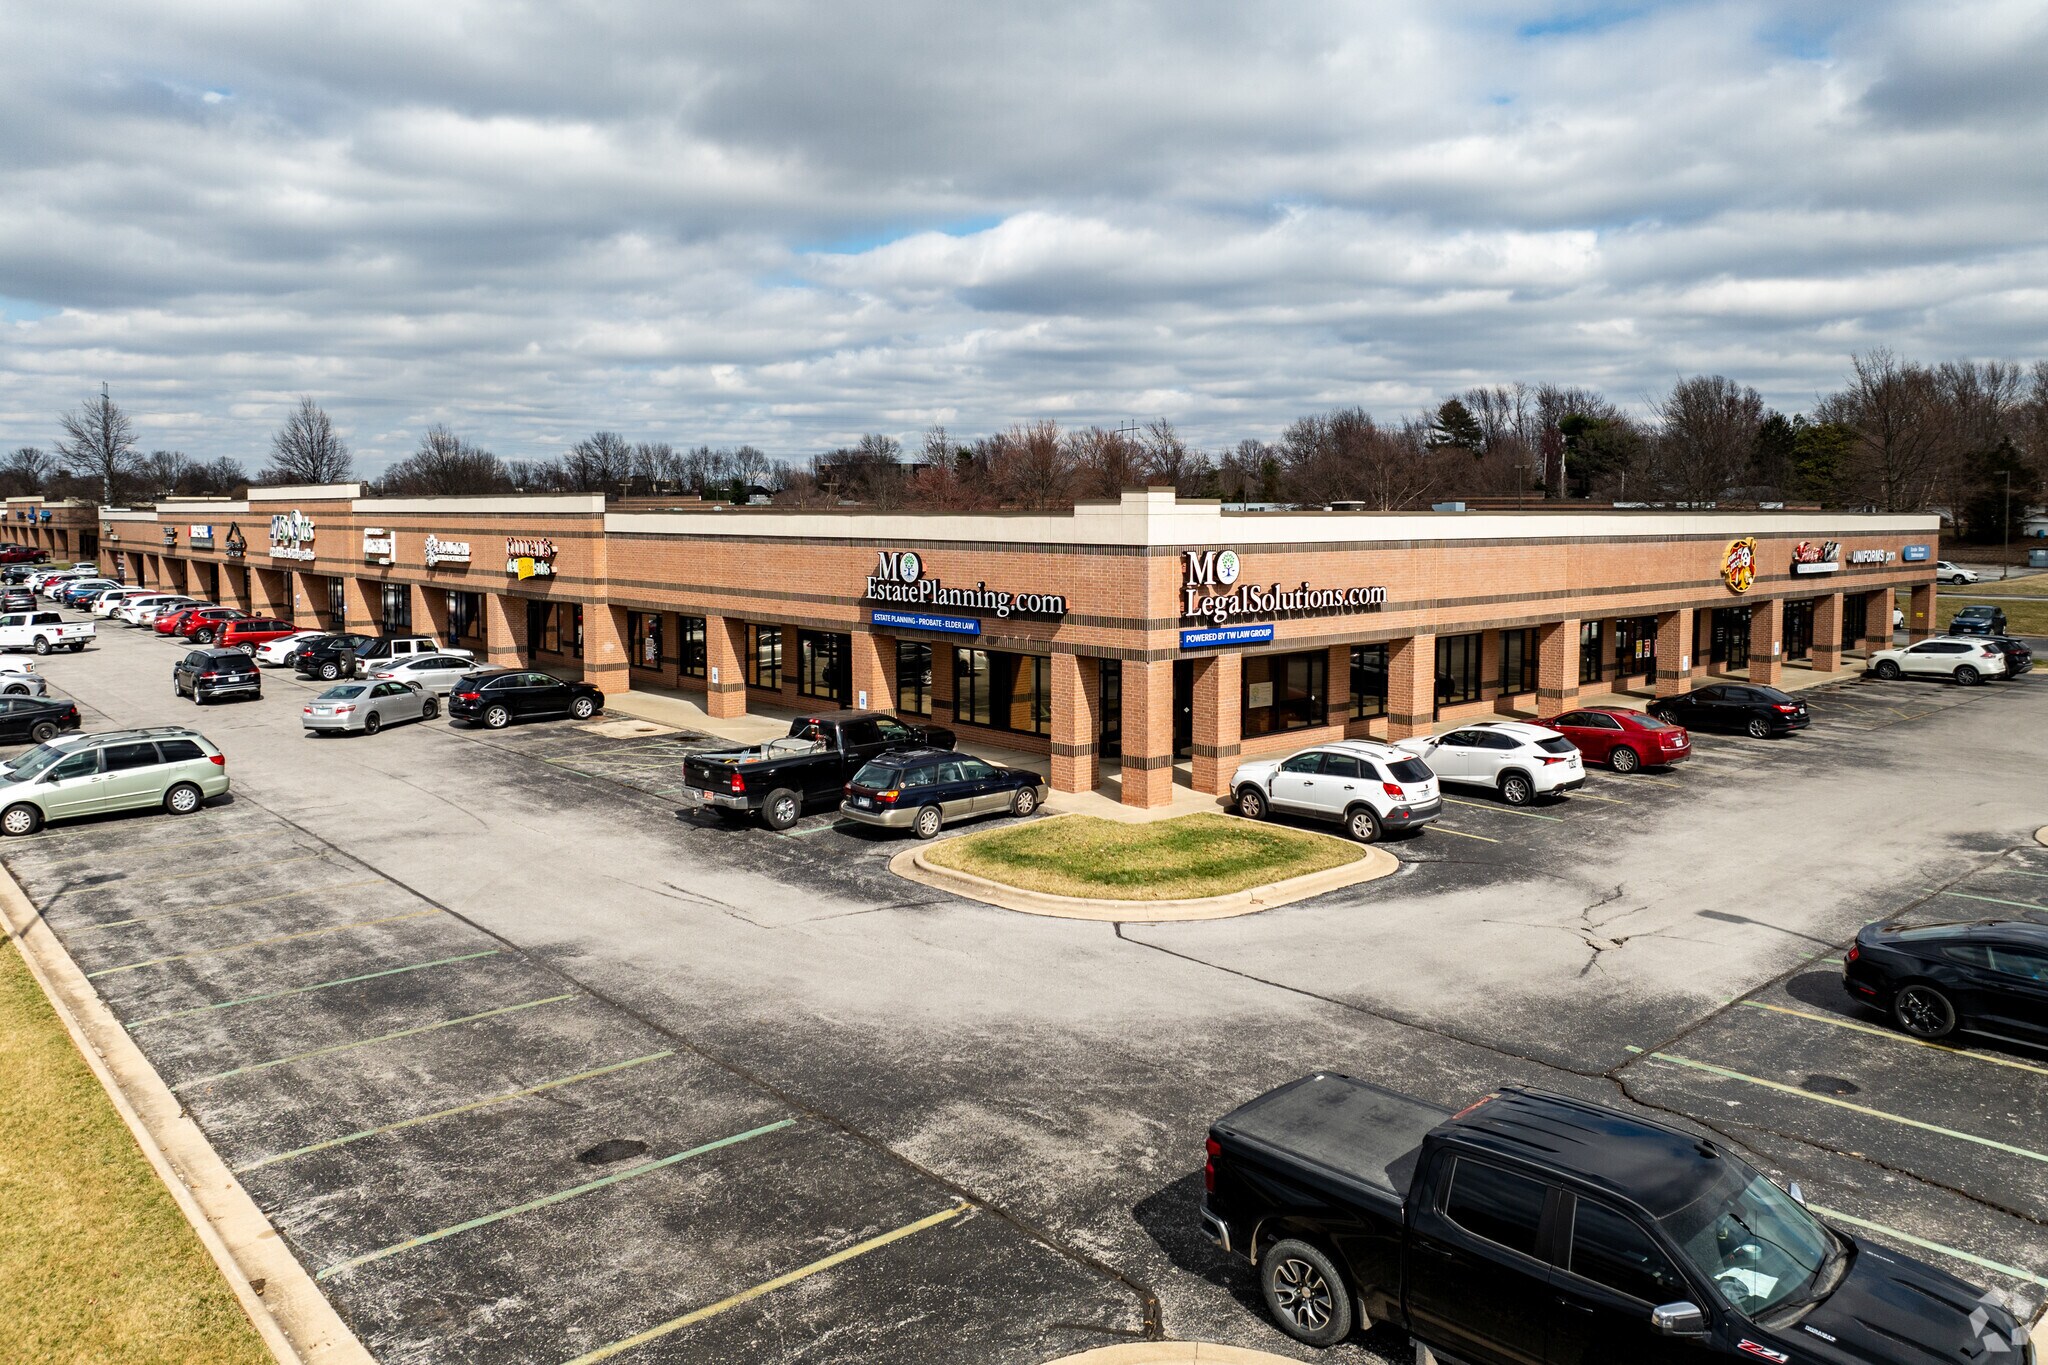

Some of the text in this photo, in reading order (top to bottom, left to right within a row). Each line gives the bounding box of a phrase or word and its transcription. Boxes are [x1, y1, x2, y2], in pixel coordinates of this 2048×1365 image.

[1853, 549, 1884, 564] UNIFORMS
[866, 575, 1064, 618] EstatePlanning.com
[1185, 581, 1388, 623] LegalSolutions.com
[874, 613, 891, 622] ESTATE
[891, 615, 915, 625] PLANNING
[918, 618, 942, 627] PROBATE
[945, 620, 962, 629] ELDER
[962, 622, 975, 630] LAW
[1186, 628, 1272, 643] POWERED BY TW LAW GROUP
